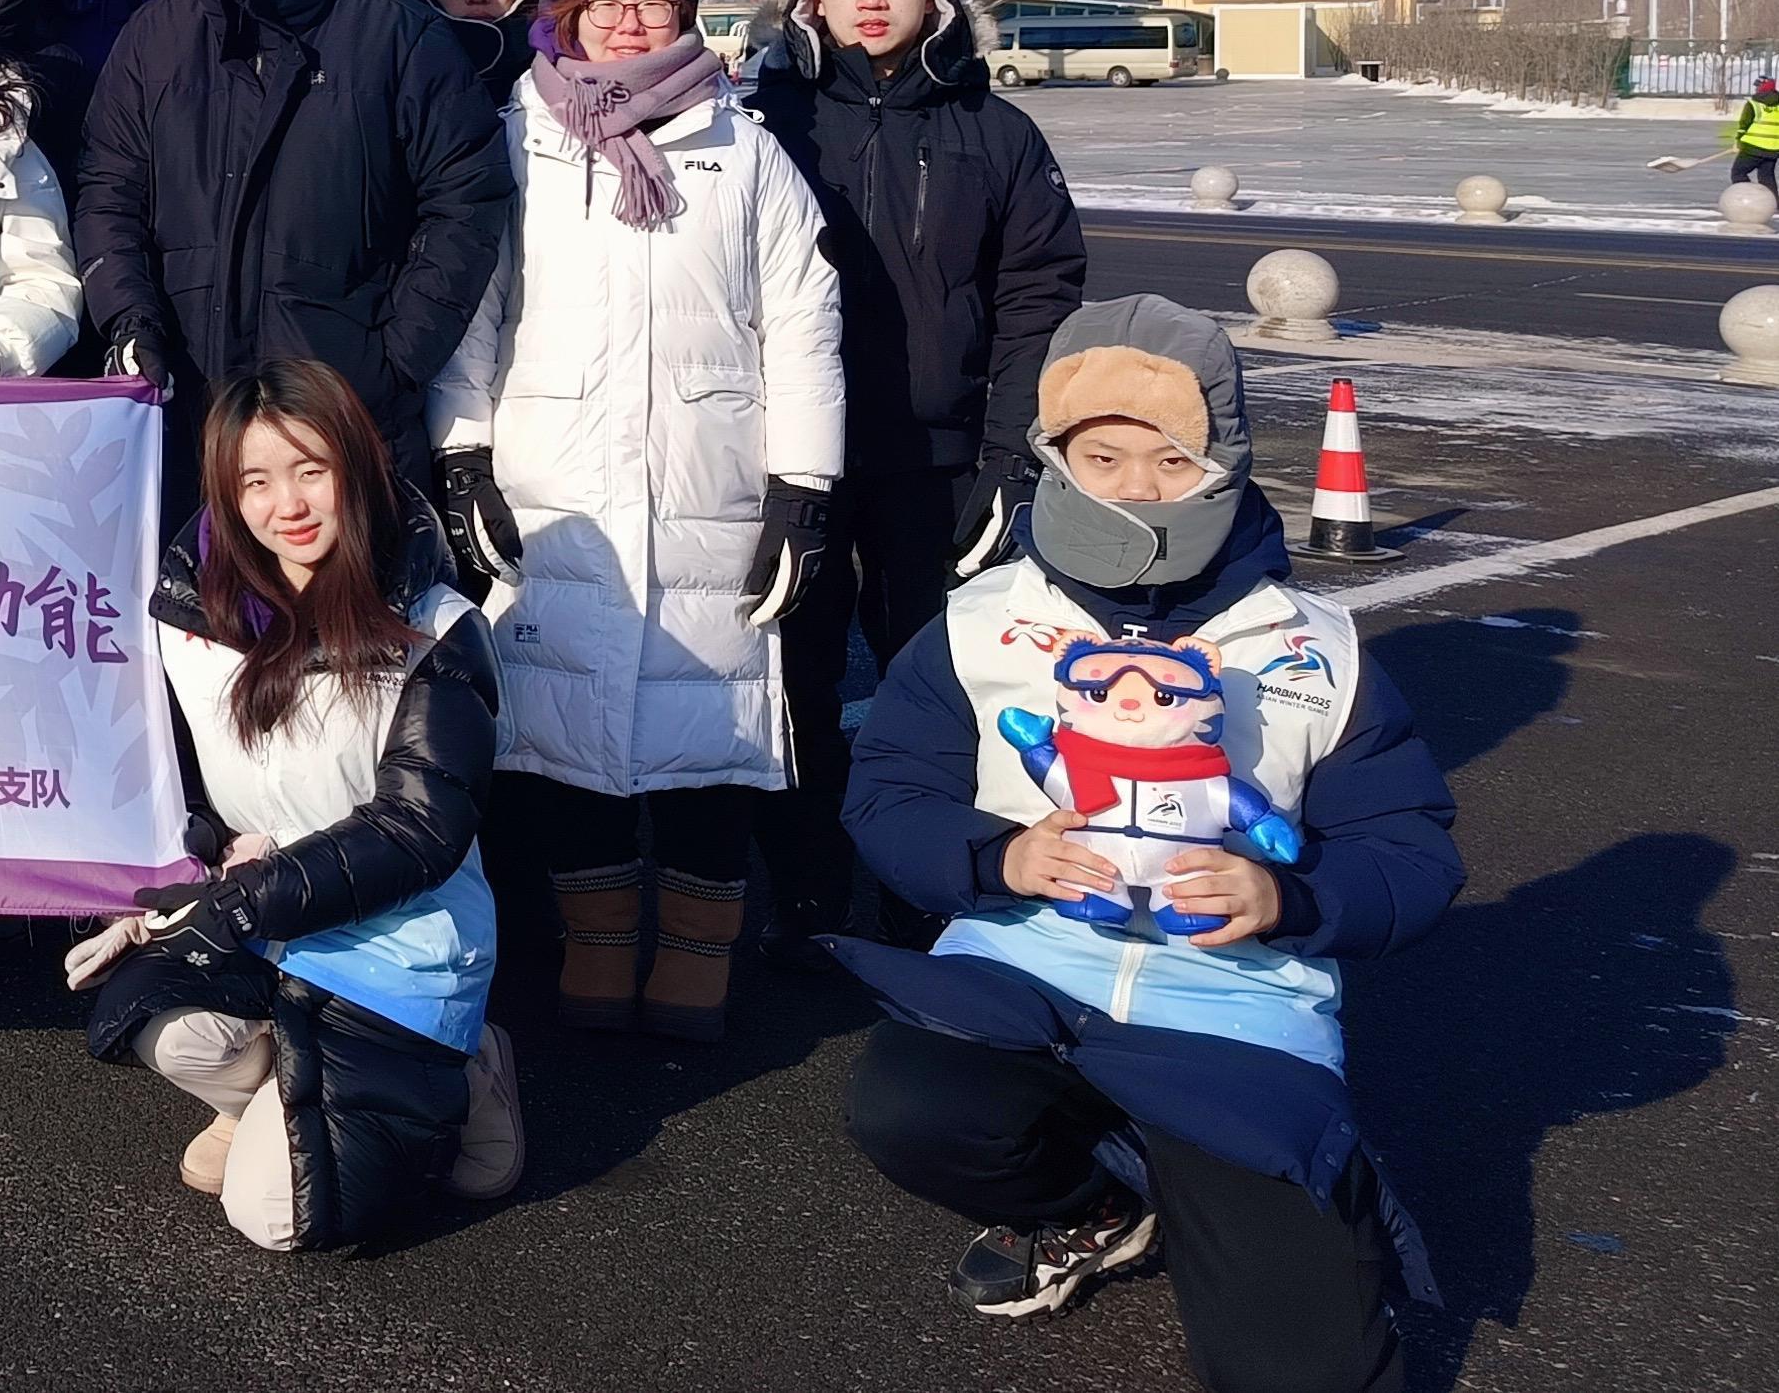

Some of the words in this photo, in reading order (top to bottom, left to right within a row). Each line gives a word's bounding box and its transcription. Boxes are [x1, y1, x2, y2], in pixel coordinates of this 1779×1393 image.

[685, 161, 722, 172] FILA
[1256, 683, 1302, 700] HARBIN
[1304, 694, 1333, 710] 2025
[1279, 699, 1306, 710] WINTER
